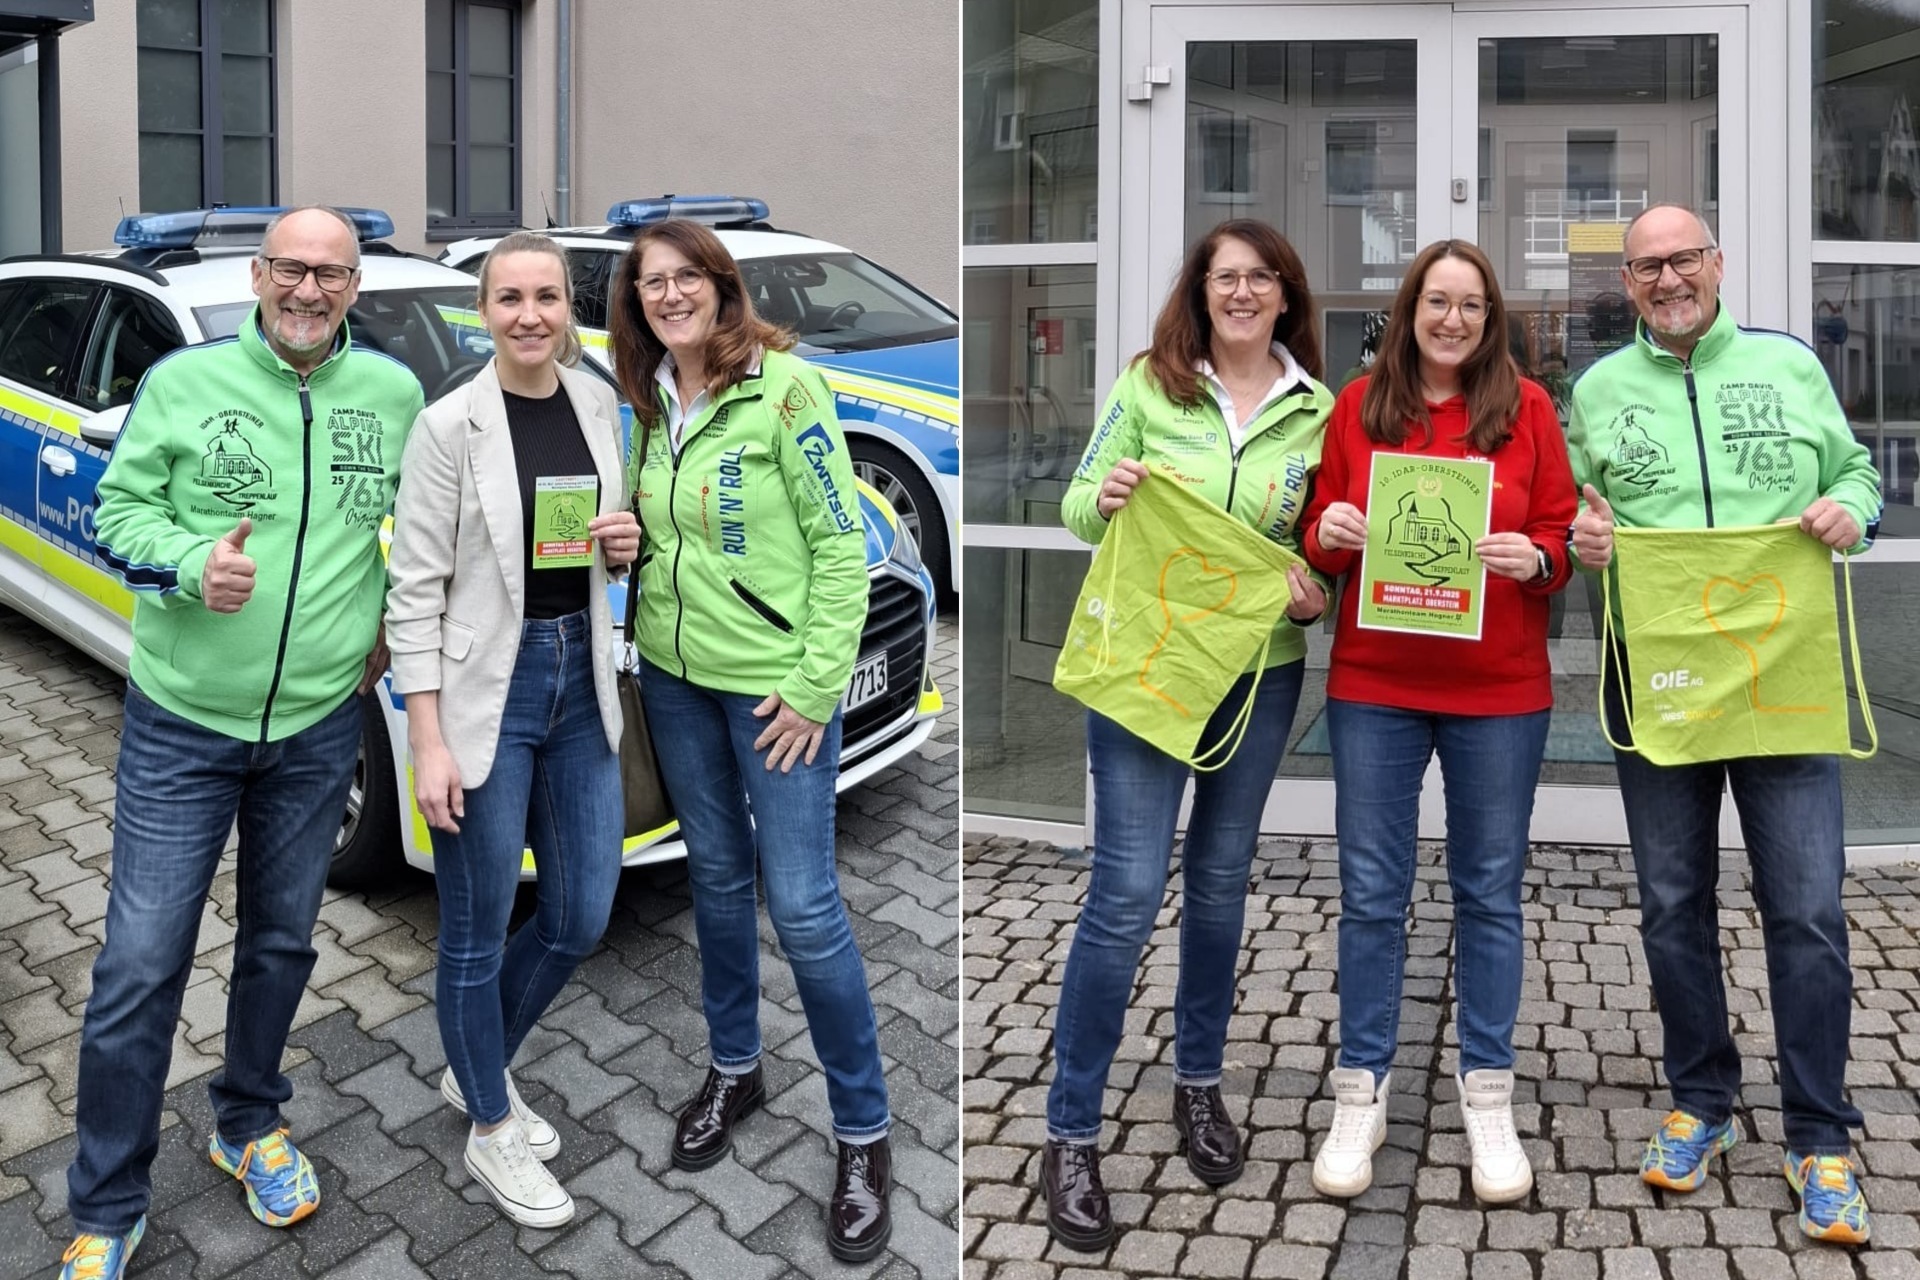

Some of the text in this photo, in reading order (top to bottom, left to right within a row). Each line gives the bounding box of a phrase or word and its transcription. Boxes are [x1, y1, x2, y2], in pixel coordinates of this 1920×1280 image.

[1714, 390, 1784, 404] ALPINE
[356, 409, 376, 419] DAVID
[1720, 403, 1786, 432] SKI
[327, 416, 384, 435] ALPINE
[331, 431, 384, 466] SKI
[1726, 443, 1739, 453] 25
[719, 444, 747, 489] ROLL
[1284, 453, 1306, 493] ROLL
[332, 476, 344, 485] 25
[1749, 469, 1797, 492] Original
[190, 505, 276, 522] Marathonteam Hagner
[721, 520, 747, 556] RUN
[1384, 585, 1460, 599] SONNTAG, 21.9.2025
[1383, 595, 1460, 609] MARKTPLATZ OBERSTEIN
[1377, 606, 1454, 620] Marathonteam Hagner
[1650, 669, 1704, 691] OIE AG
